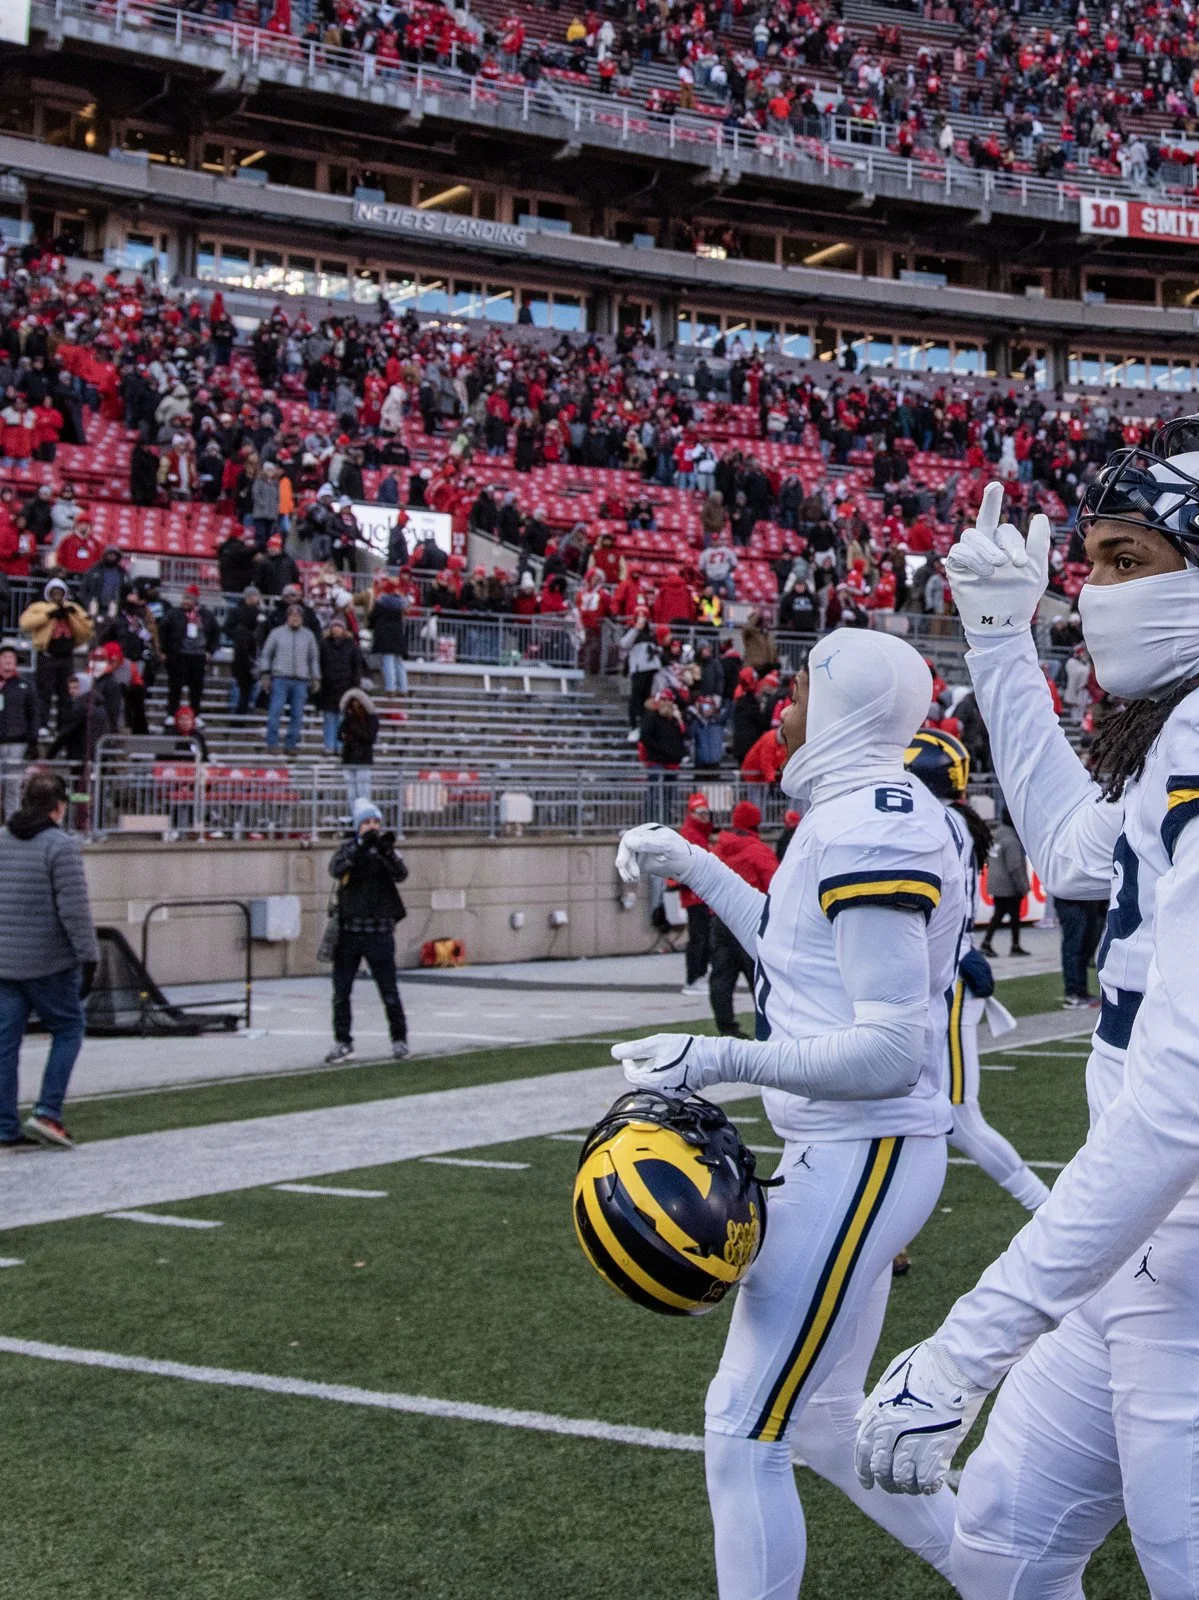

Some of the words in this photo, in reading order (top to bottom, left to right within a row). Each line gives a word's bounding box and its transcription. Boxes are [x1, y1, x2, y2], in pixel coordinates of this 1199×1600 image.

[357, 202, 437, 231] NETJETS
[443, 213, 528, 247] LANDING
[1091, 203, 1121, 229] 10
[981, 615, 994, 625] M
[875, 787, 914, 814] 6
